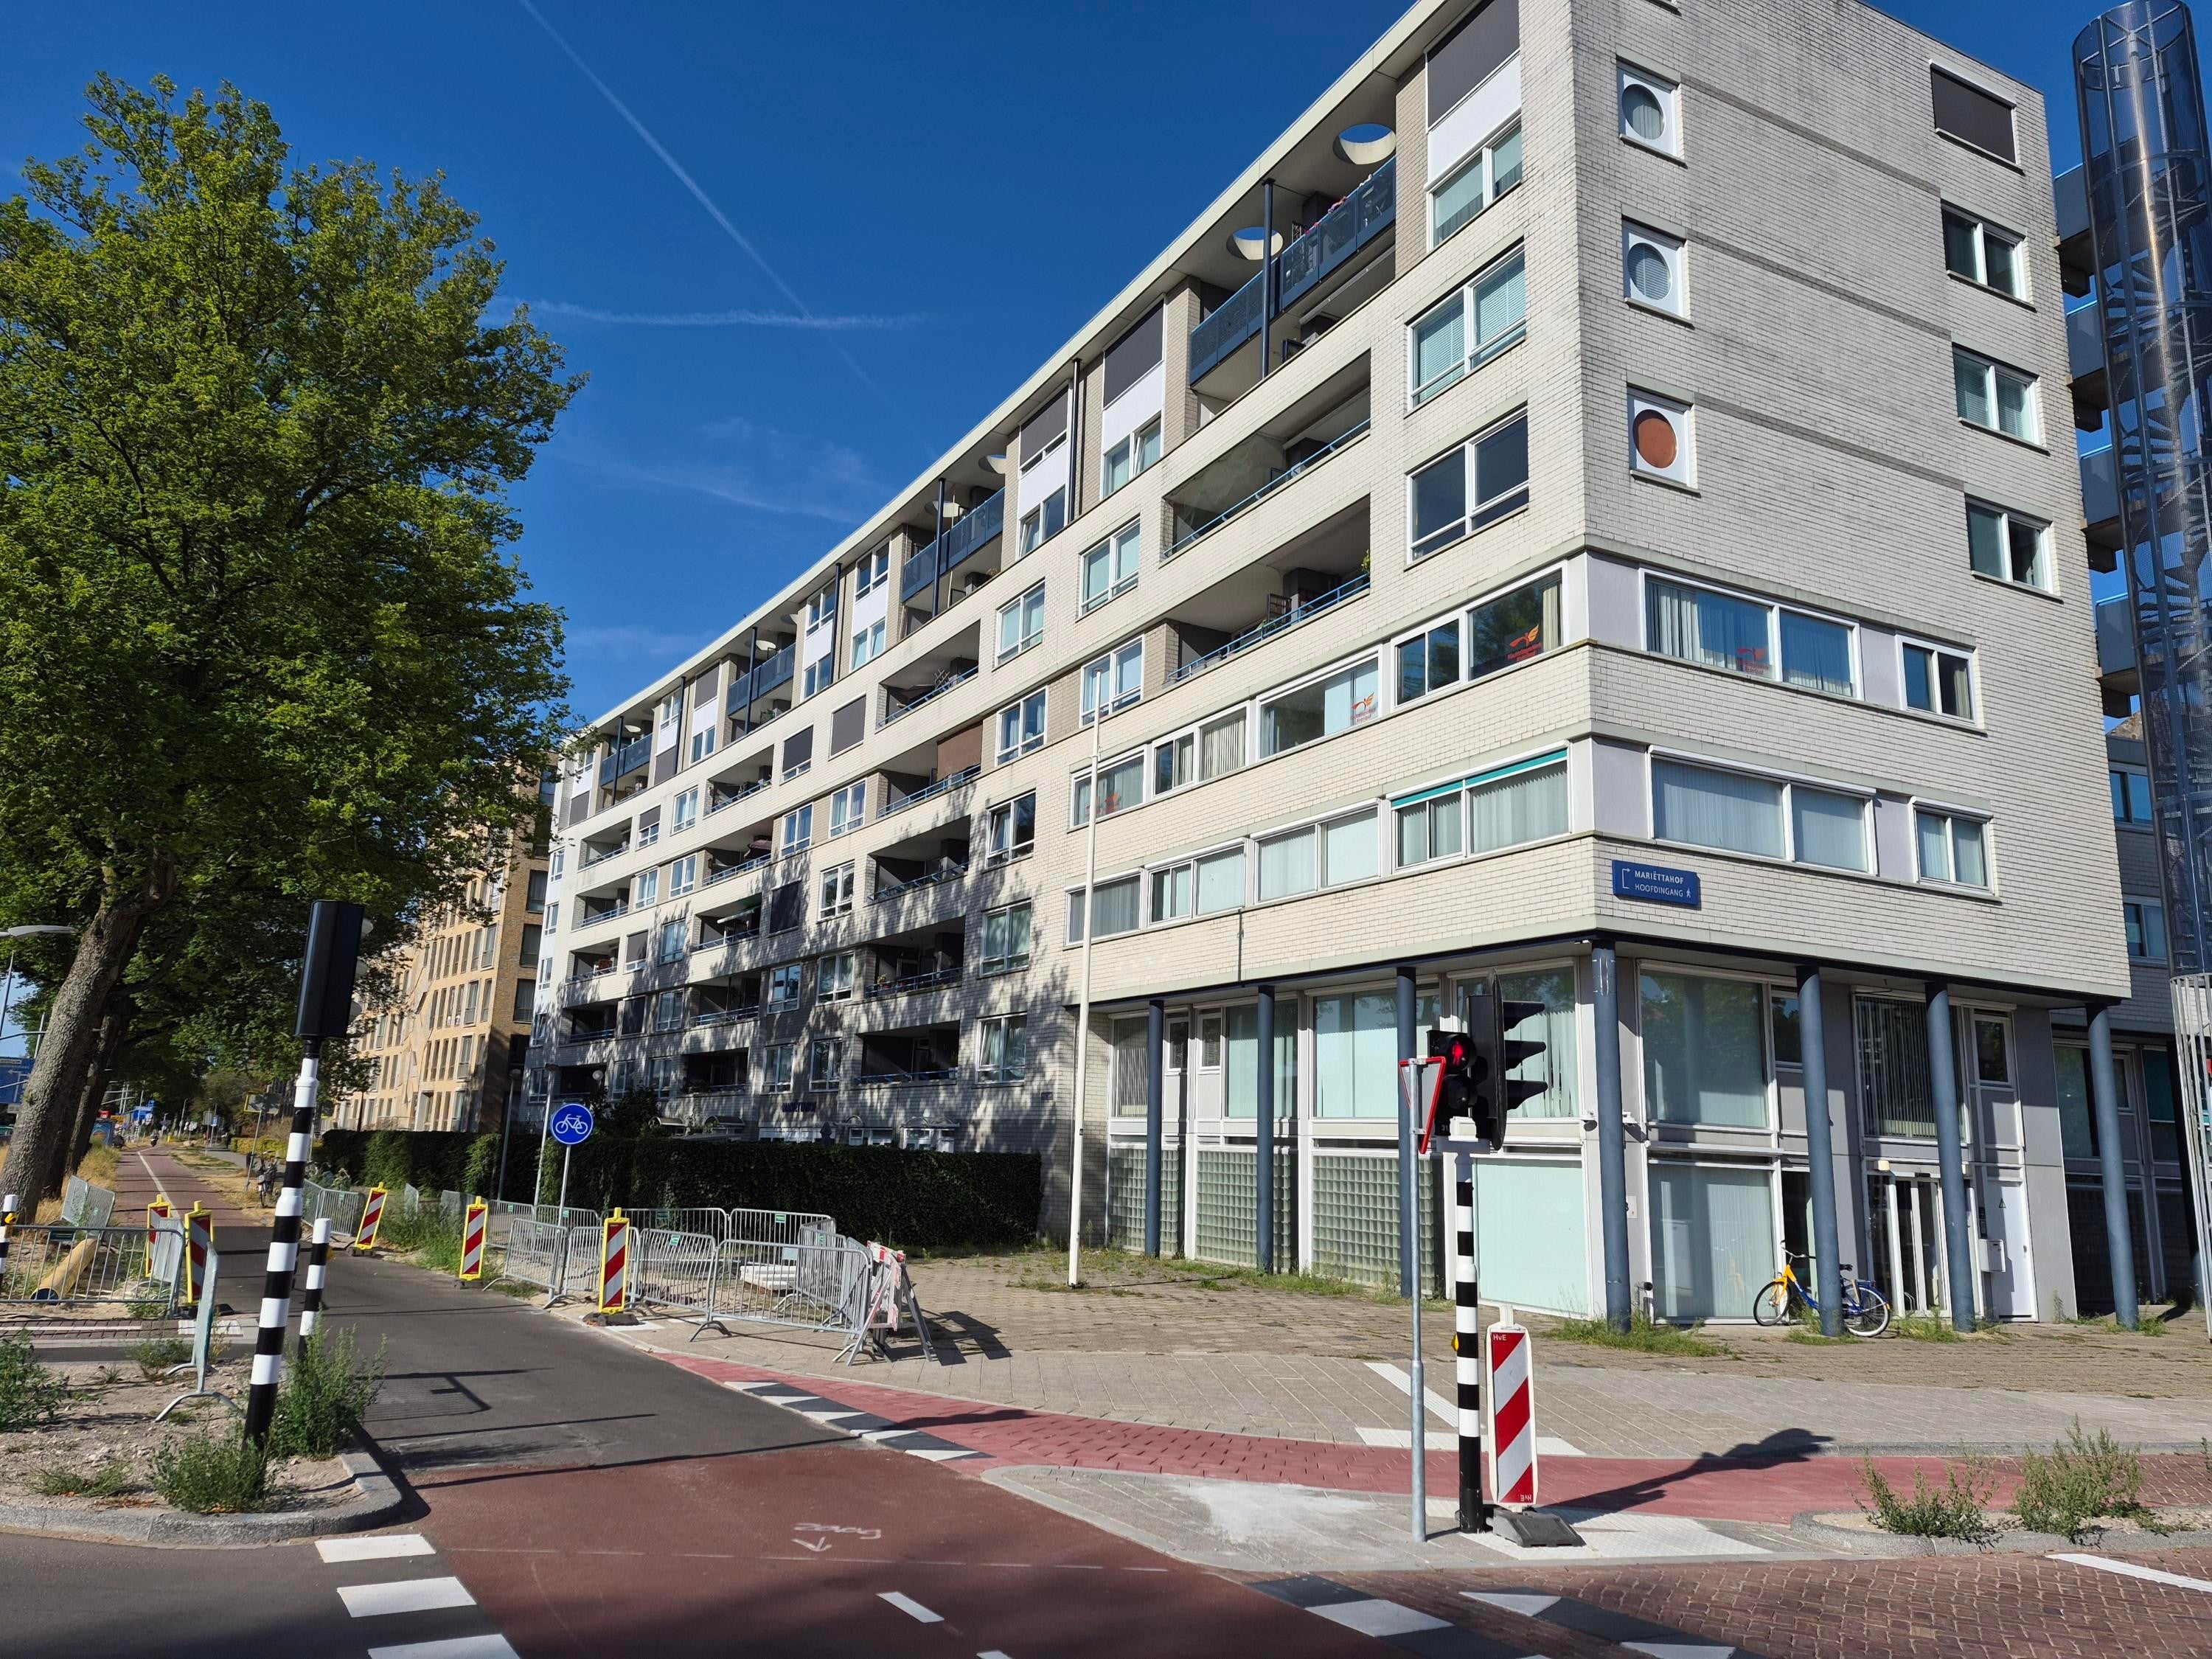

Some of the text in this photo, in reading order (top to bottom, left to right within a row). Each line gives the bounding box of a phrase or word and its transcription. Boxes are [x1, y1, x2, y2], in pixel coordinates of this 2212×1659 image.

[1635, 871, 1684, 884] MARIËTTAHOF
[1635, 883, 1684, 897] HOOFDINGANG
[1520, 1494, 1532, 1502] HvE
